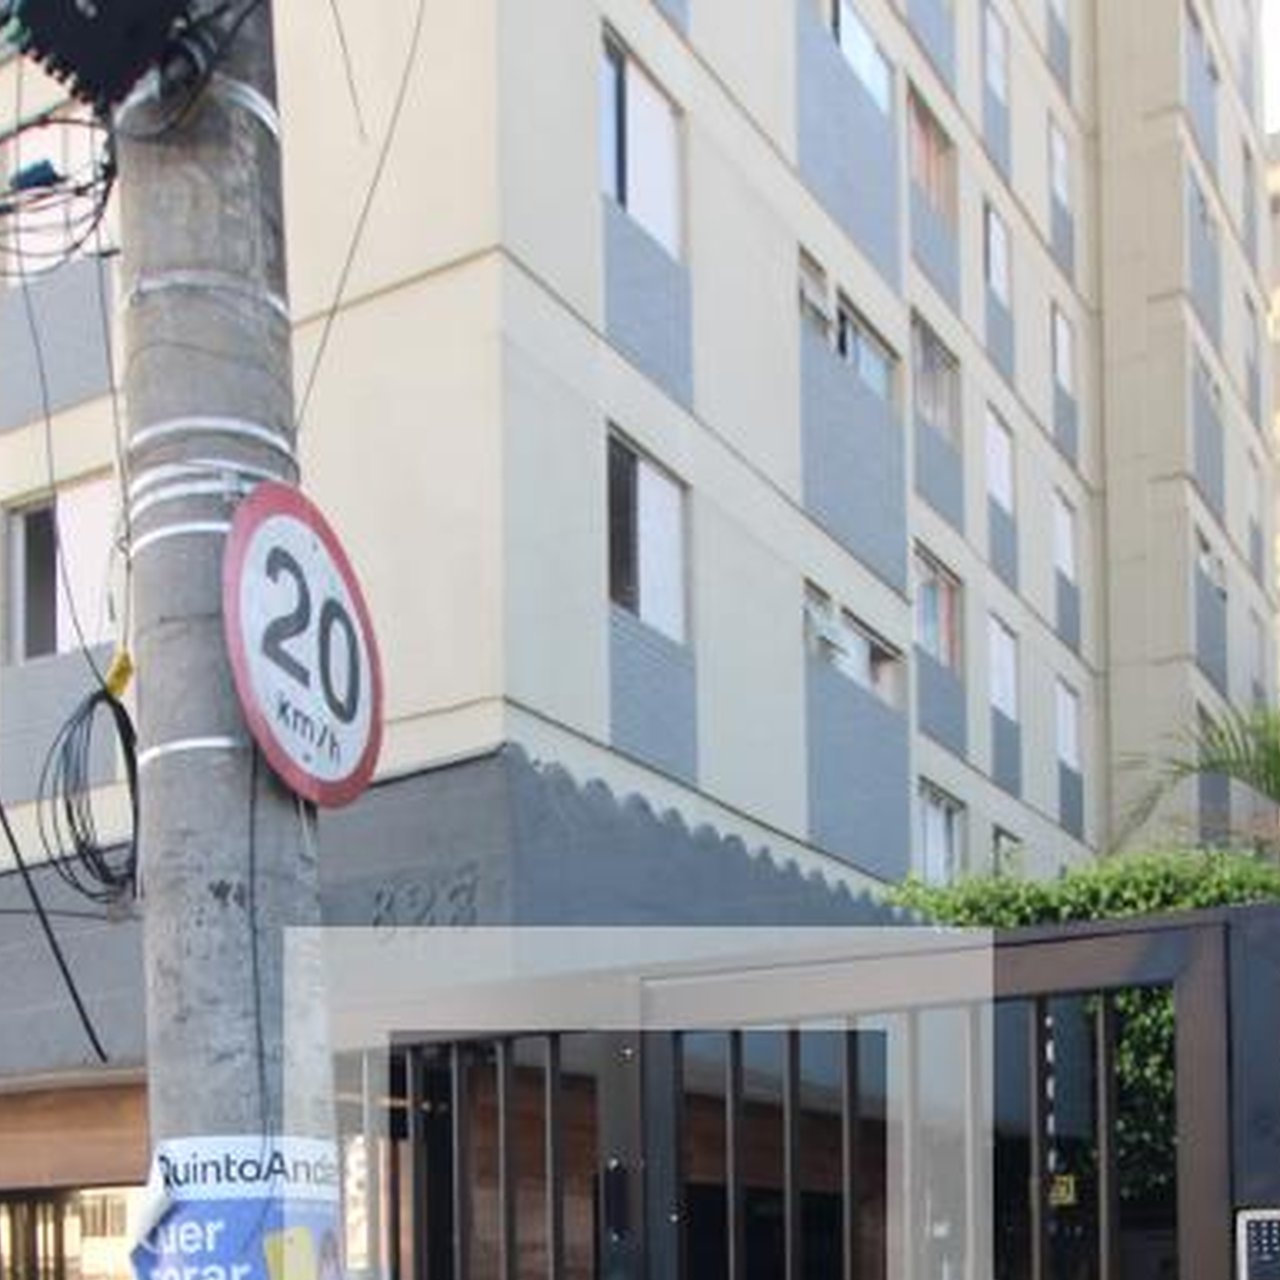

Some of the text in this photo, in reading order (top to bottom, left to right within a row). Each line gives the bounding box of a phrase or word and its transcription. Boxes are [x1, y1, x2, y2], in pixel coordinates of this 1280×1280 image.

[261, 545, 360, 725] 20
[274, 691, 341, 765] km/h
[144, 1219, 224, 1254] uer
